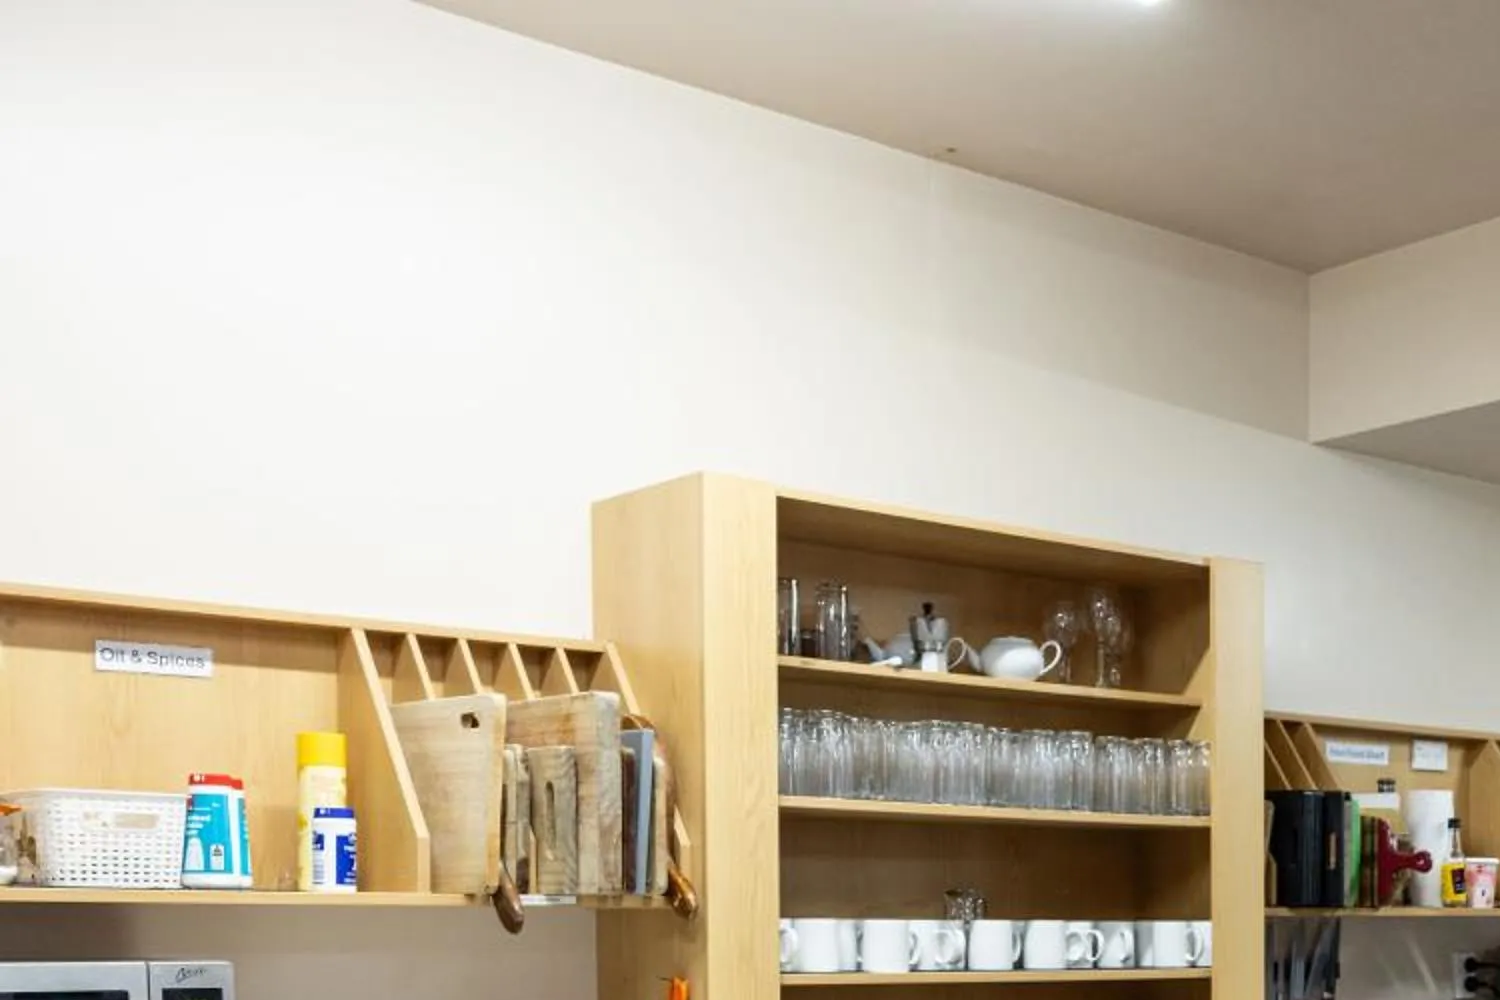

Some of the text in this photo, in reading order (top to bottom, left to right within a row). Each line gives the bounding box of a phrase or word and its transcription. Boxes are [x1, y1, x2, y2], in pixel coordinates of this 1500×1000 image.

[99, 646, 206, 669] Oil & Spices
